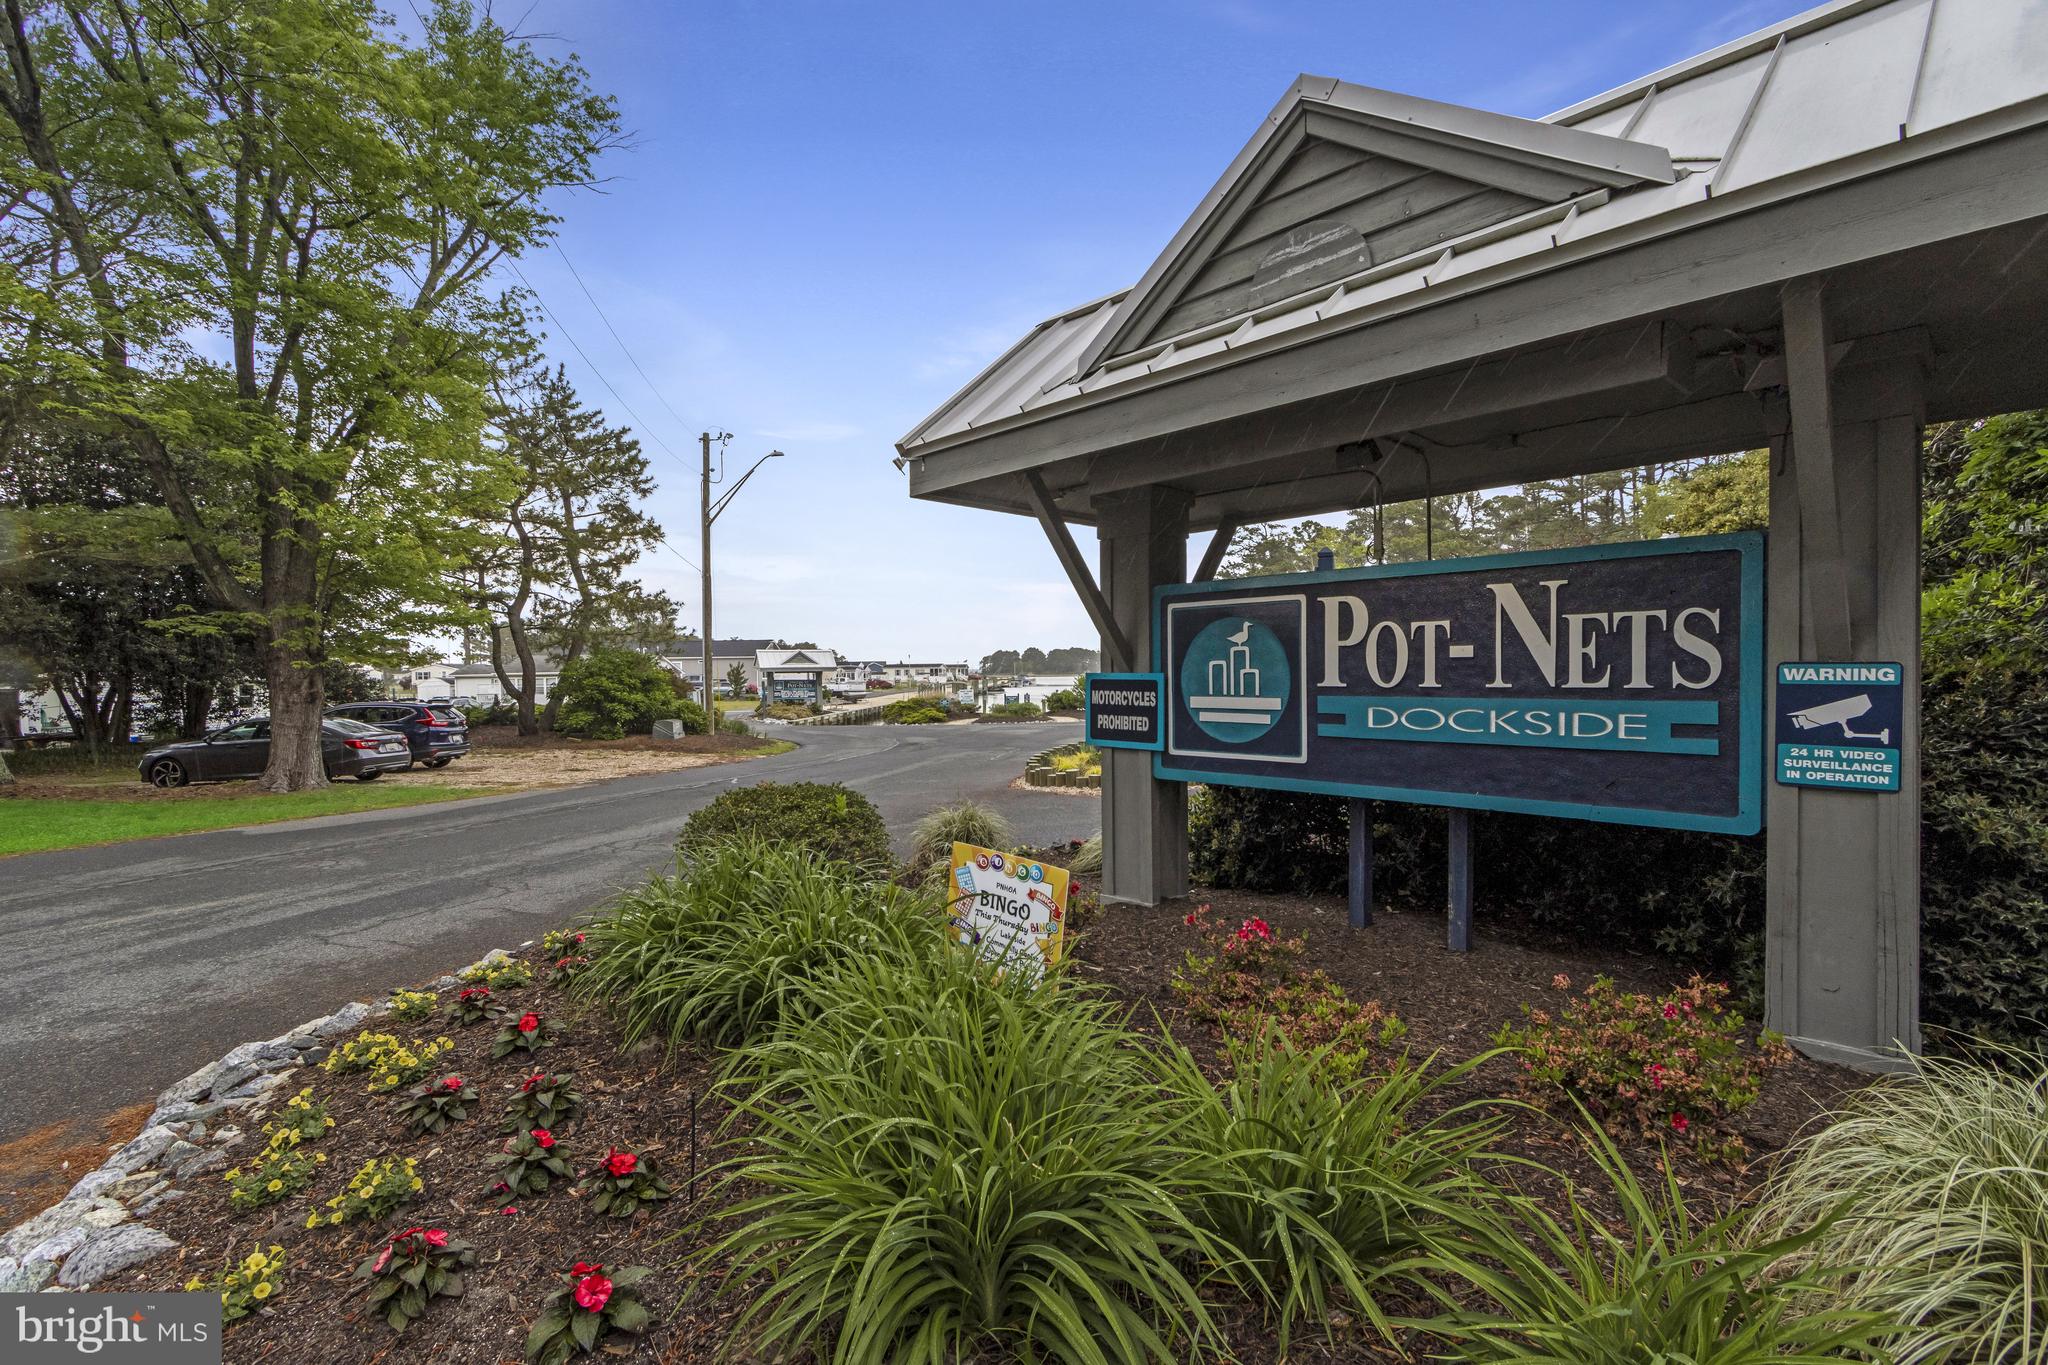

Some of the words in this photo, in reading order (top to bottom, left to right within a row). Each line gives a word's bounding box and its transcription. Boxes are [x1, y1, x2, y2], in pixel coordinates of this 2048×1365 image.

[1783, 667, 1895, 682] WARNING
[1091, 690, 1156, 707] MOTORCYCLES
[1097, 714, 1149, 732] PROHIBITED
[1367, 706, 1648, 740] DOCKSIDE
[1790, 748, 1808, 756] 24
[1814, 749, 1834, 758] HR
[1840, 750, 1886, 761] VIDEO
[1783, 759, 1893, 773] SURVEILLANCE
[1786, 770, 1800, 779] IN
[1806, 771, 1889, 784] OPERATION
[980, 890, 1031, 920] BINGO
[1035, 892, 1056, 910] BINGO
[975, 908, 992, 920] This
[993, 914, 1029, 935] Thursday
[1030, 922, 1058, 934] BINGO
